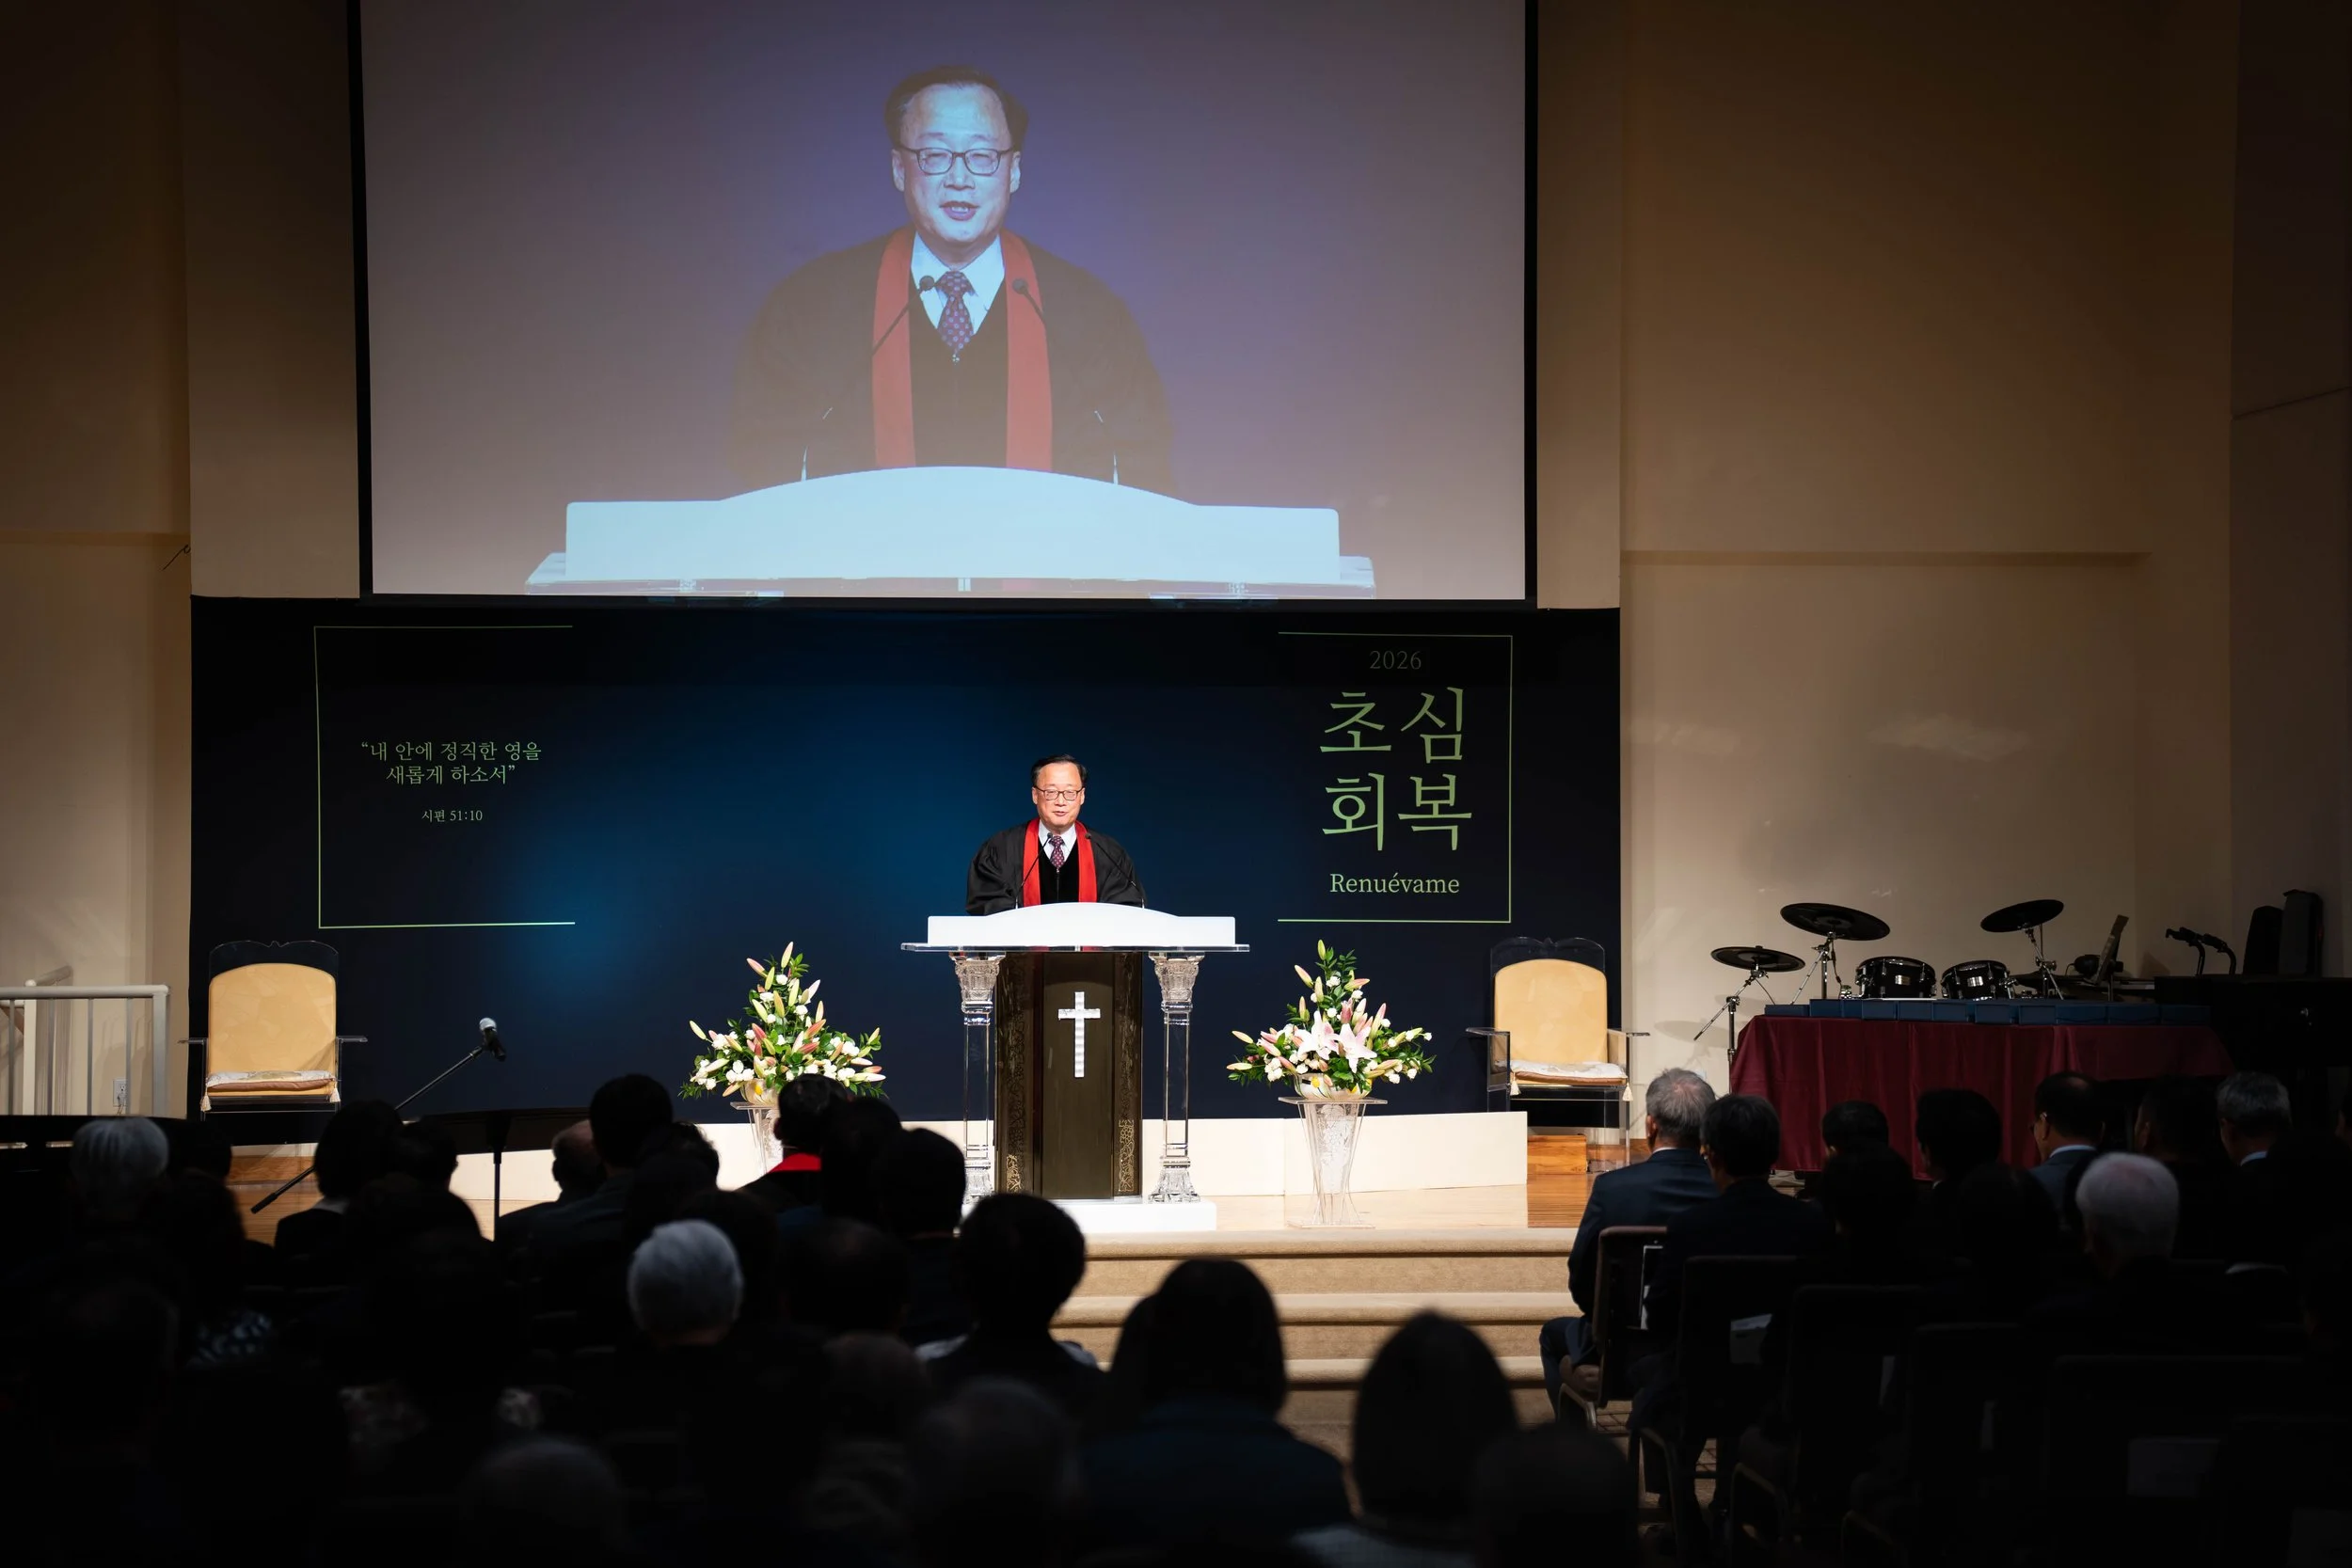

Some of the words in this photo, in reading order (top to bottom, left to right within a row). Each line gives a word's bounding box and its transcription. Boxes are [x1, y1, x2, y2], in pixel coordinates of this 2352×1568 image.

[1369, 650, 1422, 670] 2026
[1320, 686, 1464, 764] 초심
[361, 741, 387, 762] “내
[395, 741, 433, 762] 안에
[440, 741, 498, 762] 정직한
[504, 741, 542, 761] 영을
[386, 765, 443, 785] 새롭게
[451, 764, 516, 785] 하소서”
[421, 809, 445, 823] 시편
[450, 810, 484, 822] 51:10
[1322, 772, 1472, 851] 회복
[1329, 872, 1460, 894] Renuévame
